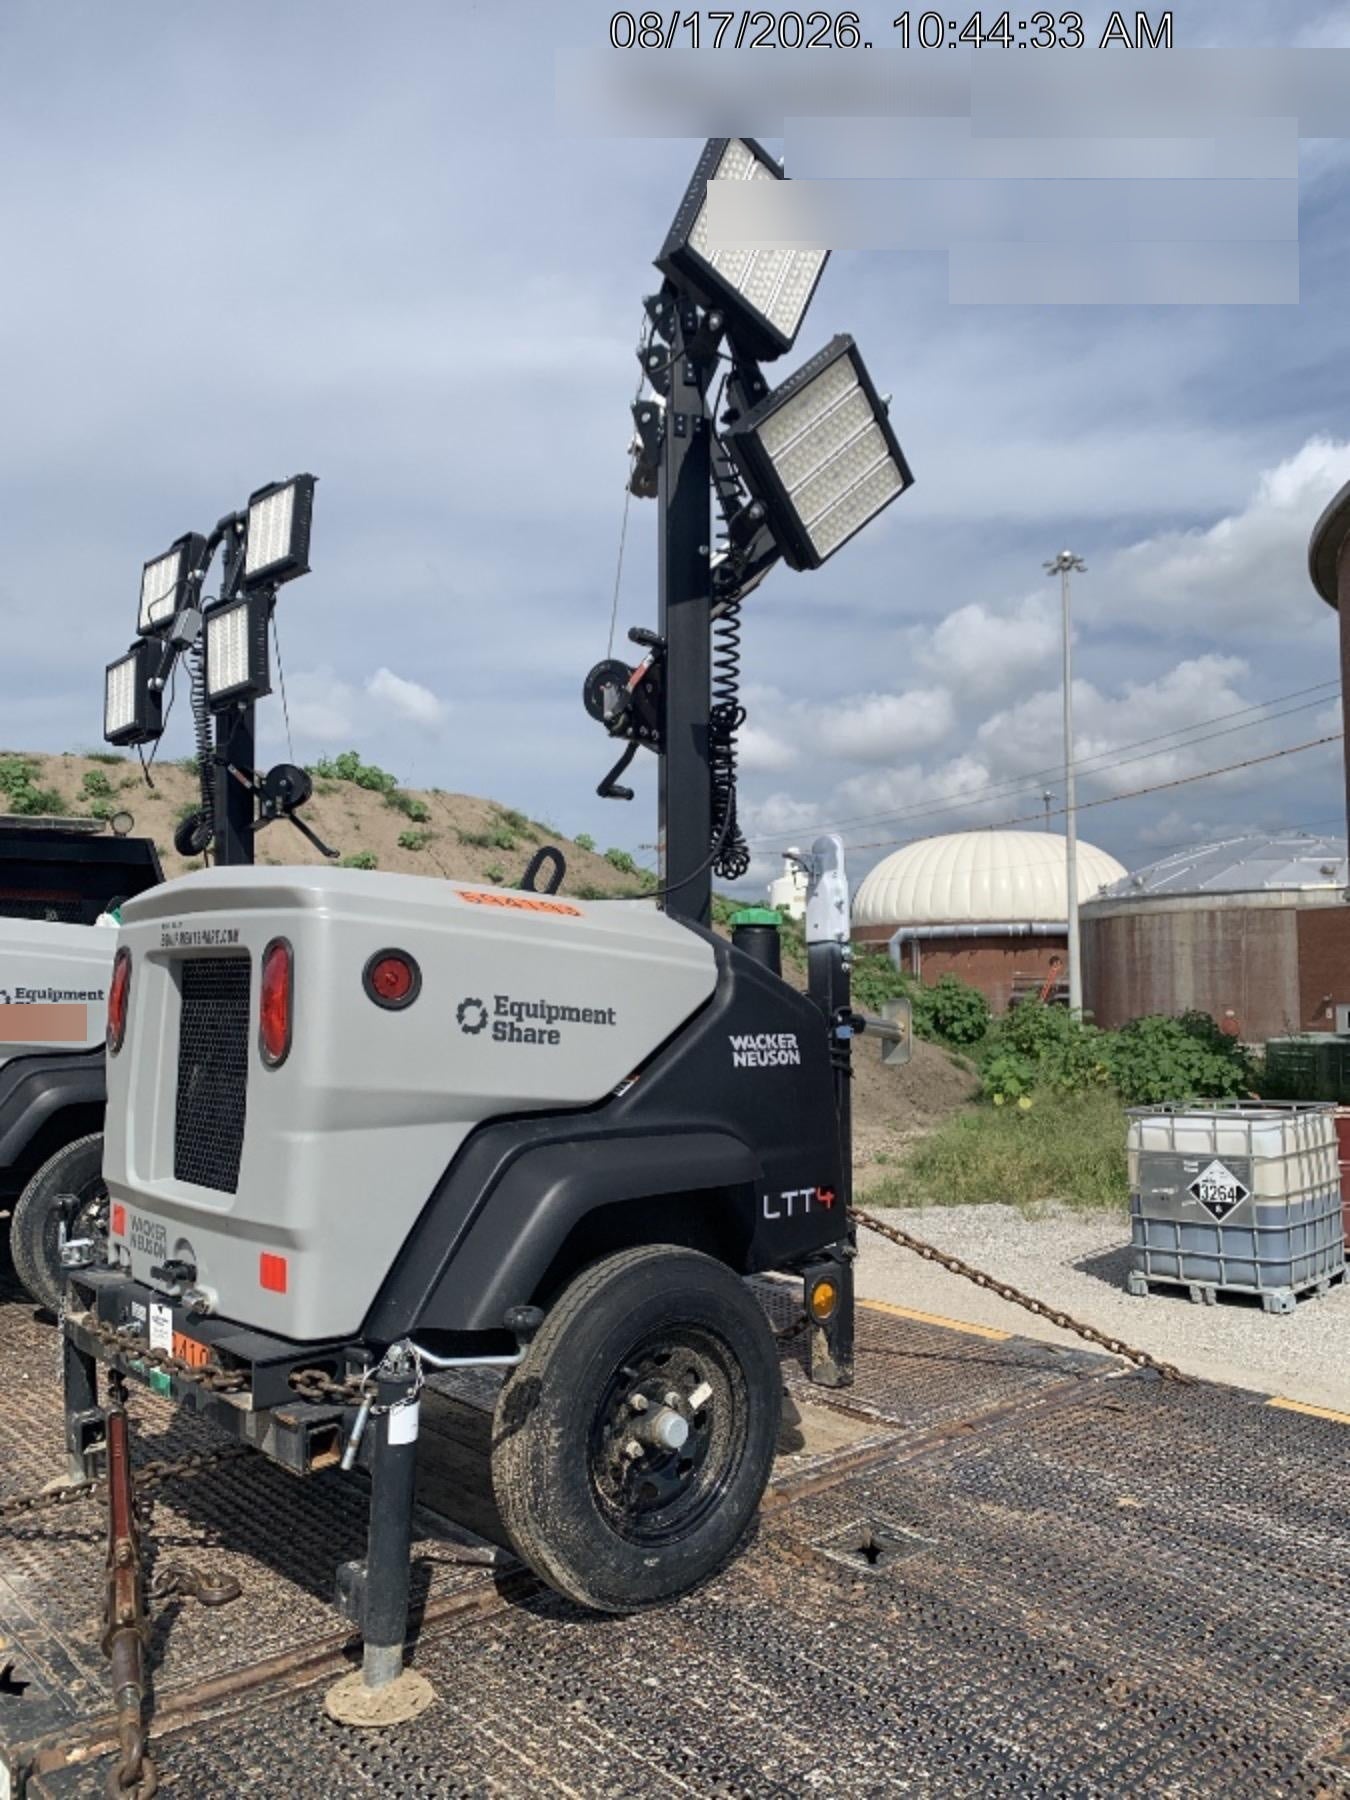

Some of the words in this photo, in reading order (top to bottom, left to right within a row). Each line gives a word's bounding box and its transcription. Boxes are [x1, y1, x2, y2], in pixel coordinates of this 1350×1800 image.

[15, 987, 105, 1003] Equipment
[493, 995, 617, 1026] Equipment
[492, 1021, 561, 1045] Share
[728, 1033, 799, 1051] WACKER
[732, 1049, 801, 1068] NEUSON
[763, 1186, 835, 1219] LTT4
[1201, 1184, 1236, 1203] 3264
